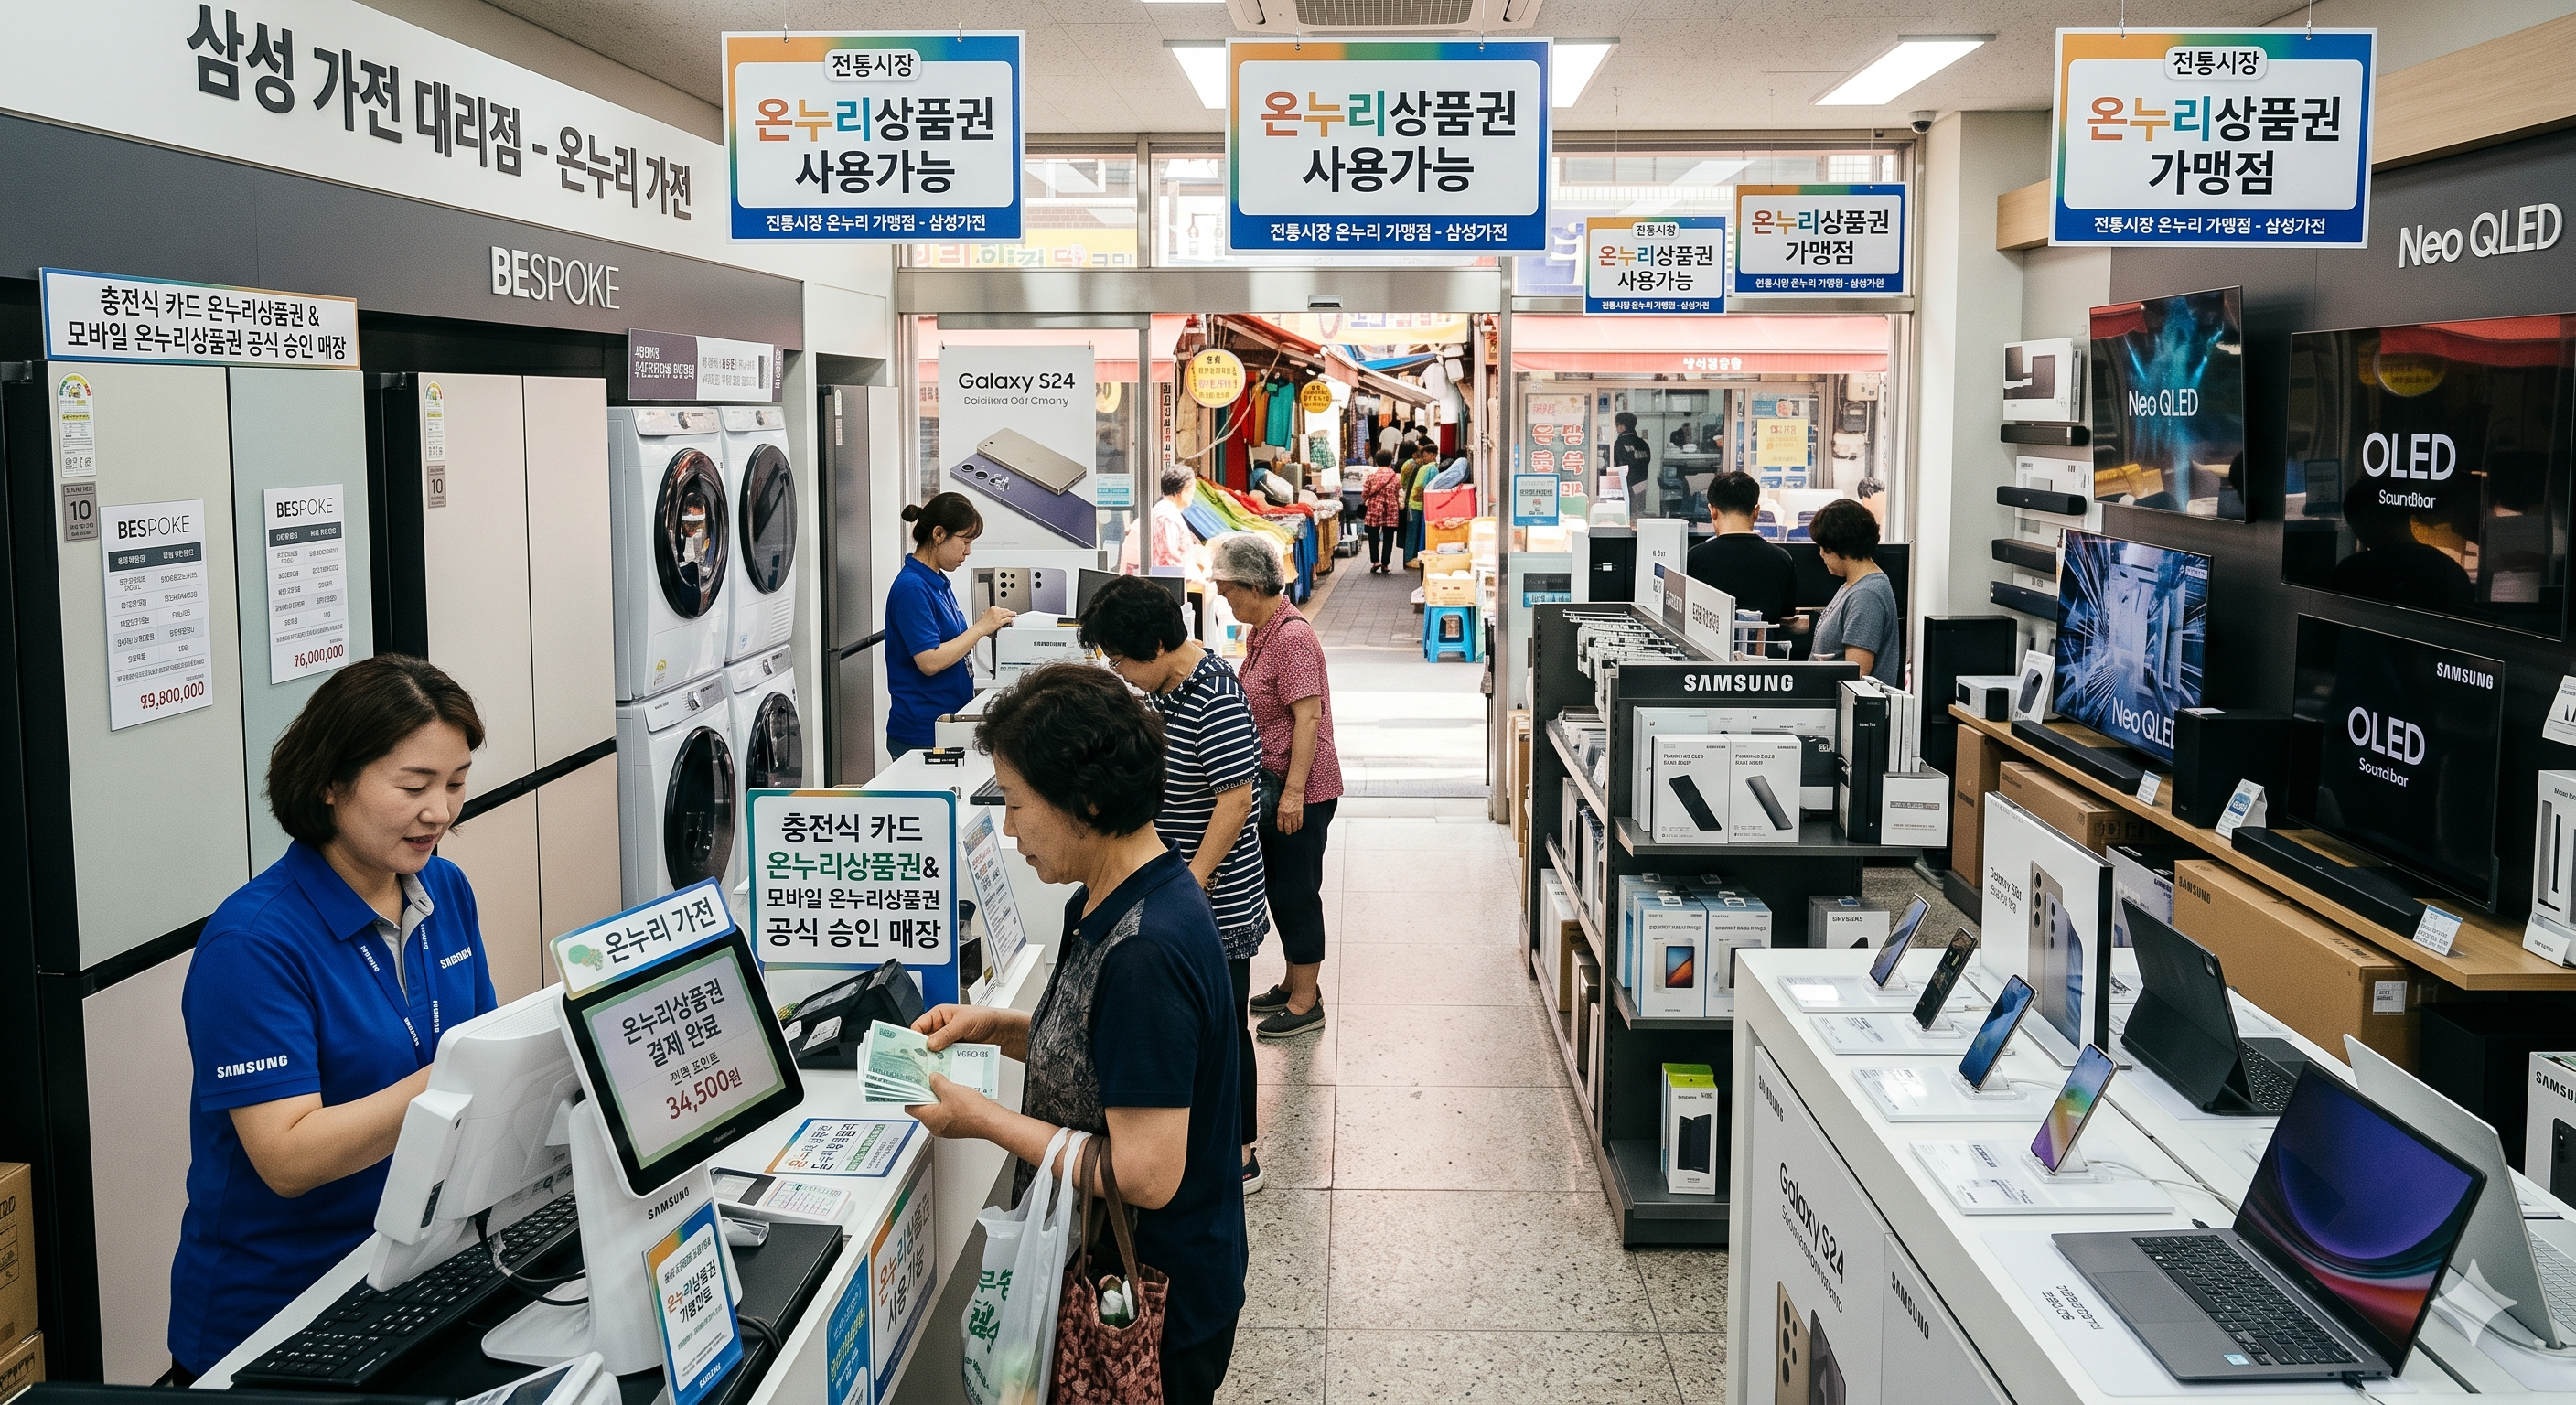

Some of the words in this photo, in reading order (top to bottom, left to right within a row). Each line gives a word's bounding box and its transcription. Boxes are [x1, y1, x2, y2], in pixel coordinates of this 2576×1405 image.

[832, 54, 914, 77] 전통시장
[2174, 51, 2259, 76] 전통시장
[187, 3, 296, 114] 삼성
[313, 47, 403, 145] 가전
[415, 81, 522, 177] 대리점
[531, 140, 549, 155] -
[556, 125, 639, 209] 온누리
[646, 156, 692, 221] 가전
[754, 96, 993, 142] 온누리상품권
[1261, 90, 1516, 137] 온누리상품권
[2087, 95, 2341, 142] 온누리상품권
[795, 150, 955, 194] 사용가능
[1303, 146, 1475, 193] 사용가능
[2149, 150, 2274, 196] 가맹점
[826, 215, 868, 231] 온누리
[873, 215, 915, 231] 가맹점
[928, 215, 986, 231] 삼성가전
[1271, 223, 1331, 241] 전통시장
[1336, 223, 1380, 241] 온누리
[1385, 223, 1432, 241] 가맹점
[1445, 223, 1508, 241] 삼성가전
[1752, 209, 1889, 236] 온누리상품권
[2094, 217, 2153, 234] 전통시장
[2157, 217, 2202, 234] 온누리
[2265, 218, 2325, 235] 삼성가전
[2399, 222, 2463, 269] Neo
[2470, 202, 2563, 259] QLED
[1598, 245, 1712, 267] 온누리상품권
[1786, 240, 1854, 266] 가맹점
[491, 245, 620, 311] BESPOKE
[1617, 271, 1694, 291] 사용가능
[101, 285, 159, 318] 충전식
[166, 291, 201, 321] 카드
[207, 293, 304, 327] 온누리상품권
[308, 305, 320, 327] &
[68, 321, 128, 352] 모바일
[134, 324, 242, 358] 온누리상품권
[248, 329, 279, 358] 공식
[284, 331, 313, 359] 승인
[317, 333, 347, 361] 매장
[958, 373, 1034, 393] Galaxy
[1038, 373, 1075, 389] S24
[2129, 389, 2157, 417] Neo
[2160, 388, 2198, 417] QLED
[2363, 433, 2456, 481] OLED
[431, 478, 444, 494] 10
[70, 499, 91, 520] 10
[276, 498, 333, 519] BESPOKE
[117, 515, 191, 540] BESPOKE
[1684, 674, 1794, 692] SAMSUNG
[2437, 662, 2493, 690] SAMSUNG
[2112, 697, 2141, 732] Neo
[2348, 706, 2425, 766] OLED
[781, 813, 860, 843] 충전식
[871, 814, 923, 843] 카드
[767, 852, 939, 881] 온누리상품권&
[767, 888, 821, 910] 모바일
[829, 889, 939, 910] 온누리상품권
[606, 914, 672, 964] 온누리
[671, 896, 717, 934] 가전
[767, 918, 818, 947] 공식
[828, 918, 879, 947] 승인
[889, 918, 940, 949] 매장
[622, 978, 725, 1045] 온누리상품권
[647, 1032, 685, 1068] 결제
[684, 1014, 722, 1050] 완료
[217, 1055, 288, 1078] SAMSUNG
[666, 1067, 743, 1120] 34,500원
[2536, 1071, 2576, 1103] SAMSU
[1780, 1162, 1819, 1251] Galaxy
[1821, 1224, 1843, 1283] S24
